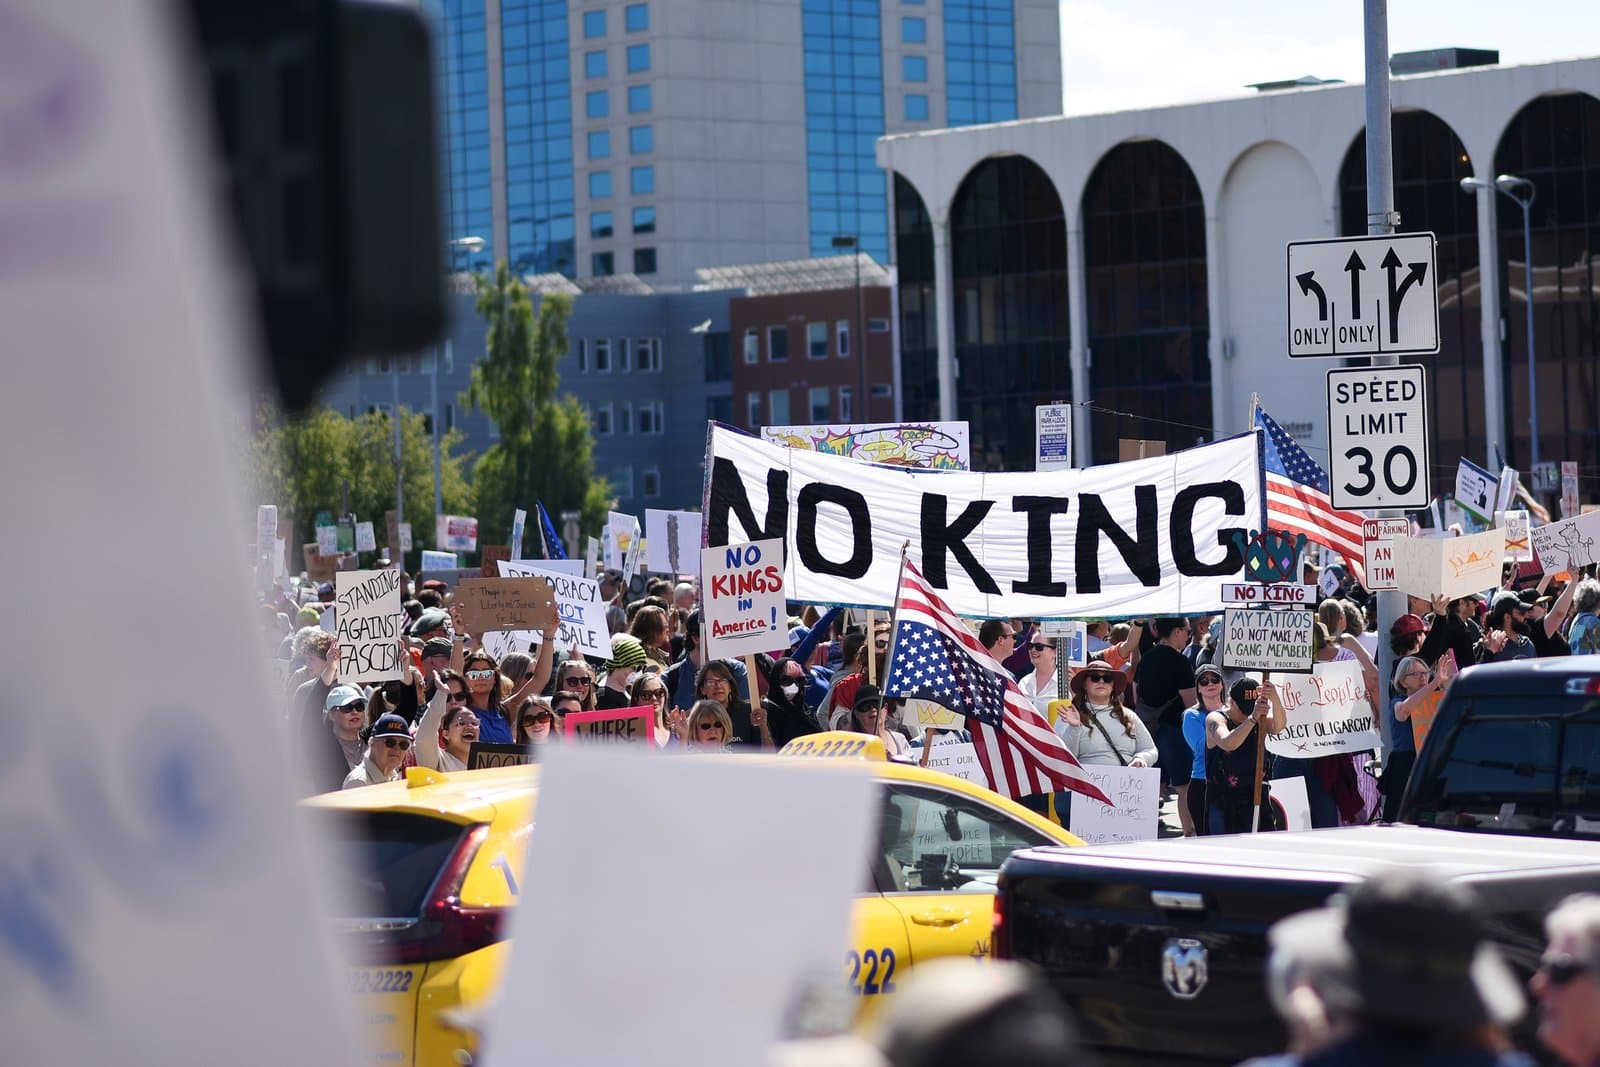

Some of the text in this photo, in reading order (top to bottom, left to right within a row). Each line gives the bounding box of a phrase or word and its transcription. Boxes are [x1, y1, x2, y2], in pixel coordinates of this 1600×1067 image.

[1294, 325, 1375, 346] ONLY ONLY
[1336, 380, 1416, 404] SPEED
[1346, 412, 1408, 436] LIMIT
[1343, 445, 1418, 497] 30
[708, 456, 1248, 597] NO KING
[1365, 524, 1407, 538] NO PARKING
[1531, 527, 1546, 536] NOT
[726, 545, 761, 569] NO
[1375, 547, 1392, 560] AN
[712, 566, 783, 599] KINGS
[1373, 567, 1395, 581] TIM
[338, 570, 400, 616] STANDING
[1234, 586, 1304, 601] NO KING
[336, 614, 400, 642] AGAINST
[1230, 611, 1311, 628] MY TATTOOS
[560, 622, 598, 649] $ALE
[1231, 628, 1308, 643] DO NOT MAKE ME
[1225, 643, 1312, 658] A GANG MEMBER!
[1235, 659, 1257, 667] FOLLOW
[1274, 660, 1300, 668] PROCESS
[1308, 676, 1363, 708] People
[577, 717, 640, 742] WHERE
[1313, 716, 1372, 737] OLIGARCHY
[957, 756, 974, 764] OUR
